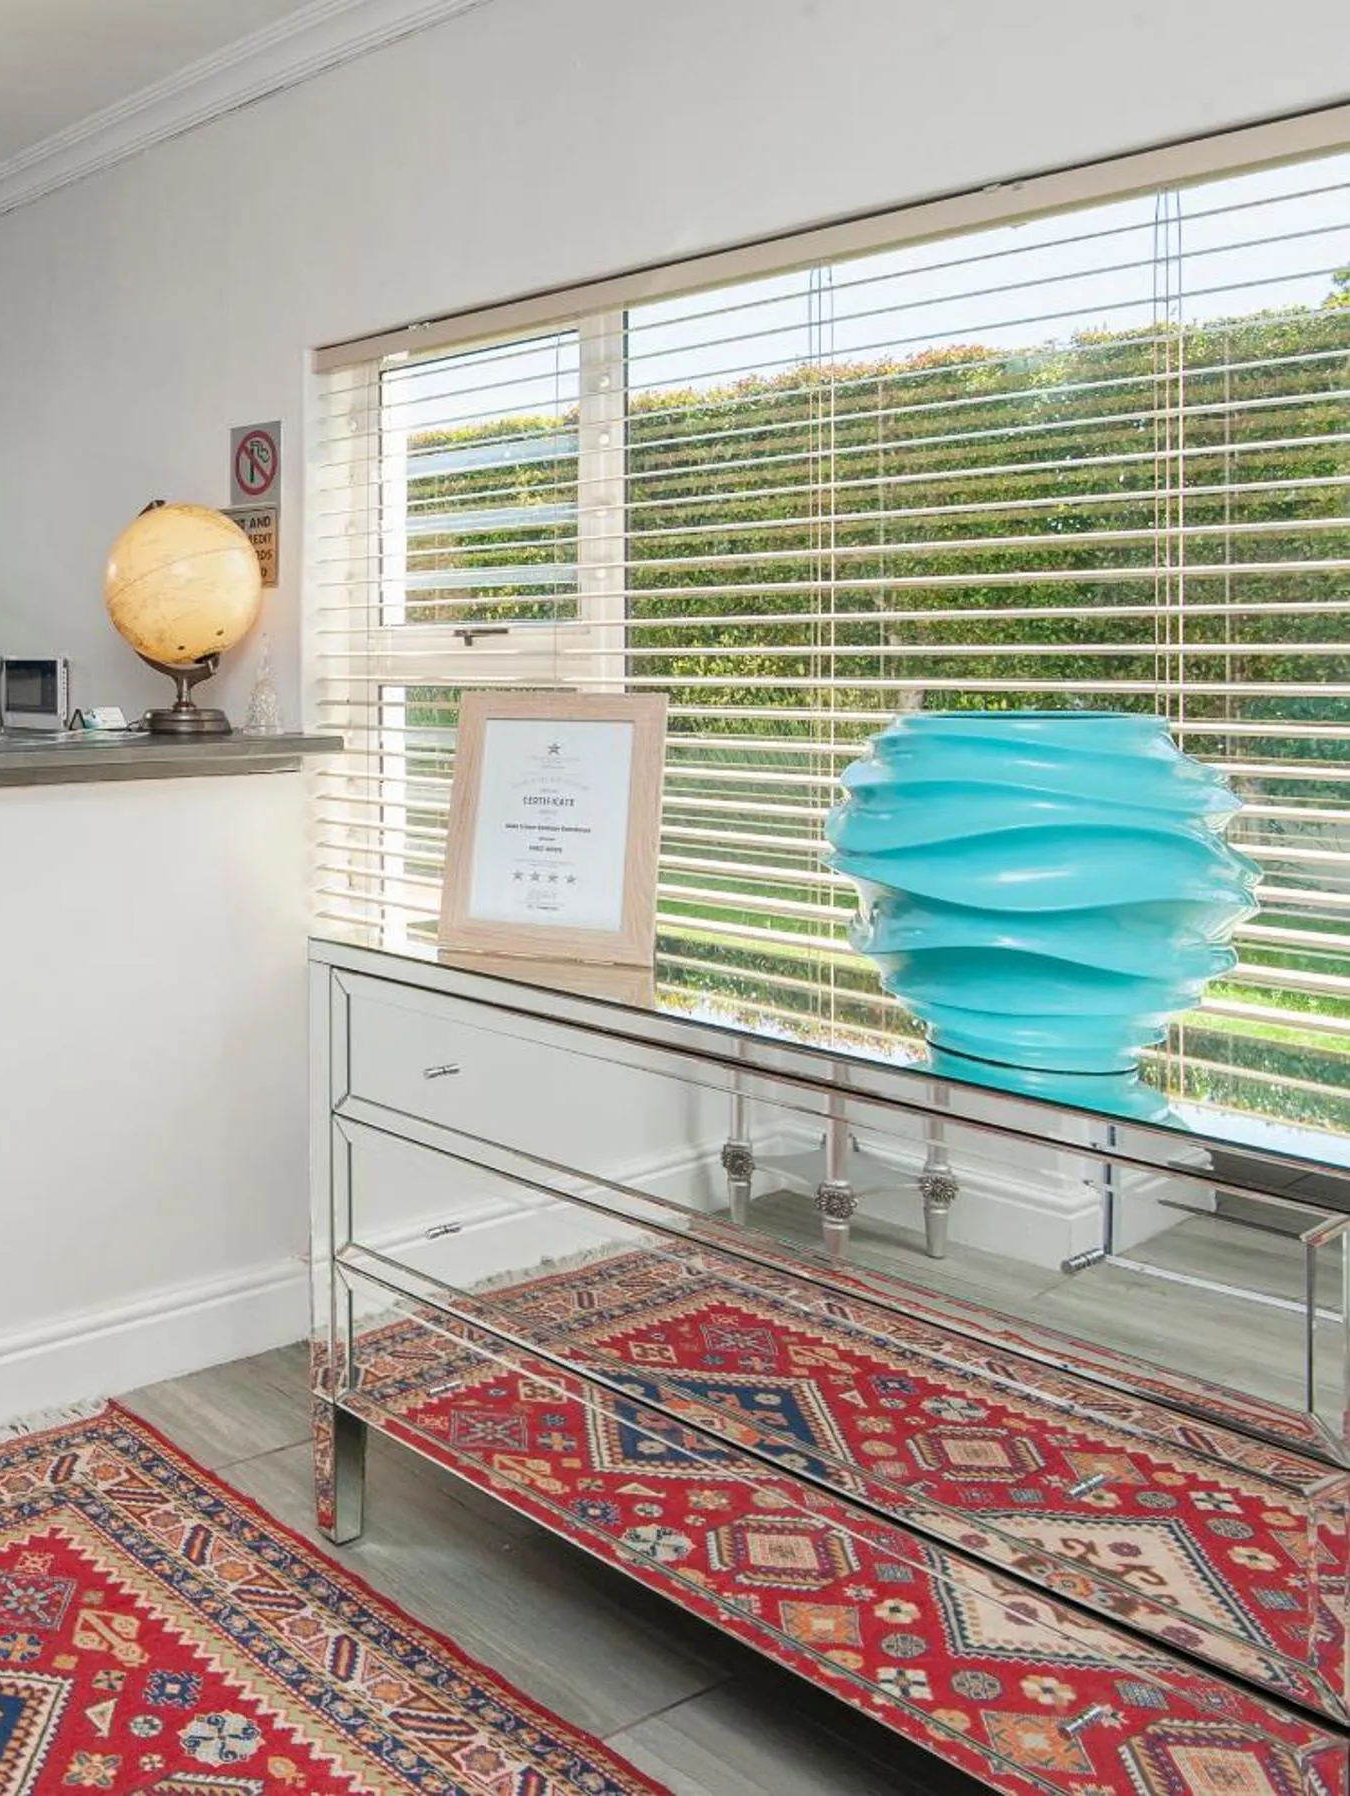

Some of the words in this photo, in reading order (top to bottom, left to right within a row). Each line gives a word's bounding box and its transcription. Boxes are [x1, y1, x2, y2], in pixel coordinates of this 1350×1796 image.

[250, 516, 271, 528] AND
[248, 533, 272, 546] REDIT
[523, 796, 575, 807] CERTIFICATE
